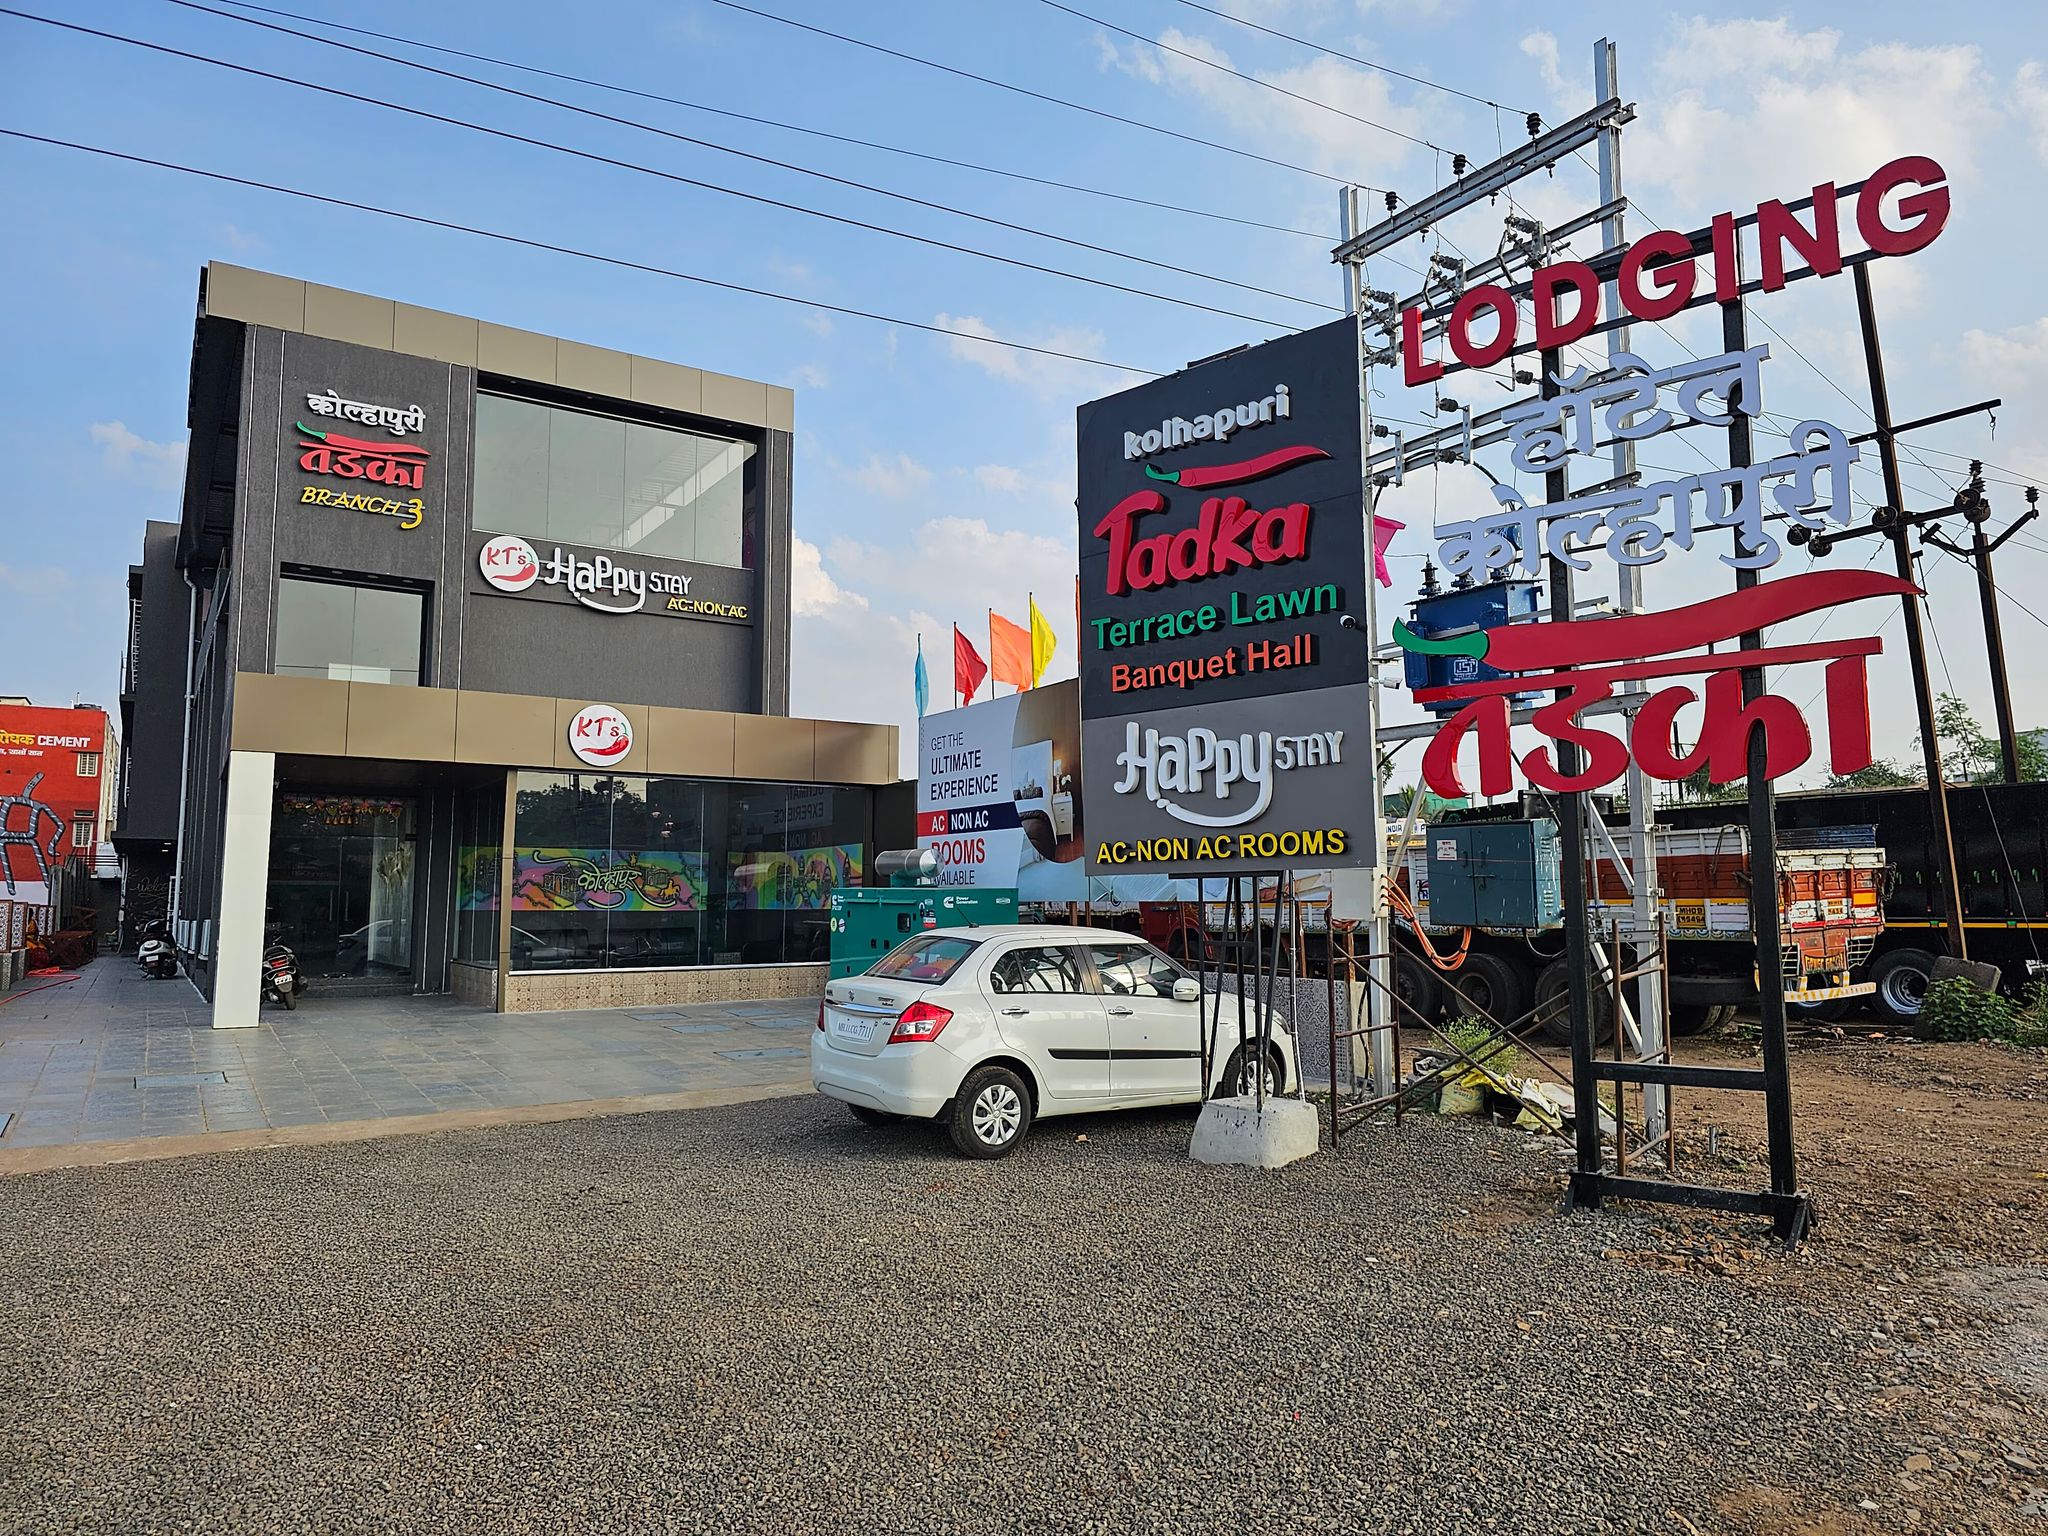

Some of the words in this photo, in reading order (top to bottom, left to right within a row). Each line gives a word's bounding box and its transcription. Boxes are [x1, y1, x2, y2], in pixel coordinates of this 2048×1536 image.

[1402, 155, 1951, 387] LODGING
[307, 389, 425, 435] कोल्हापुरी
[1124, 384, 1290, 460] kolhapuri
[1502, 343, 1771, 474] हॉटेल
[300, 441, 430, 490] तडका
[301, 486, 400, 516] BRANCH
[401, 498, 424, 530] 3
[1434, 419, 1861, 584] कोल्हापुरी
[486, 546, 527, 566] KT's
[1093, 489, 1310, 595] Tadka
[650, 572, 692, 595] STAY
[728, 605, 748, 618] AC
[1091, 604, 1217, 650] Terrace
[1231, 583, 1338, 626] Lawn
[1111, 647, 1236, 693] Banquet
[1248, 633, 1312, 671] Hall
[576, 716, 620, 739] KT's
[1413, 636, 1883, 799] तडका
[37, 735, 91, 748] CEMENT
[930, 735, 946, 751] GET
[948, 732, 964, 747] THE
[1275, 730, 1344, 770] STAY
[931, 749, 982, 776] ULTIMATE
[930, 774, 998, 801] EXPERIENCE
[931, 815, 945, 833] AC
[951, 812, 972, 831] NON
[974, 810, 989, 829] AC
[1096, 837, 1189, 864] AC-NON
[1196, 835, 1231, 860] AC
[1239, 829, 1345, 859] ROOMS
[933, 869, 976, 886] VAILABLE
